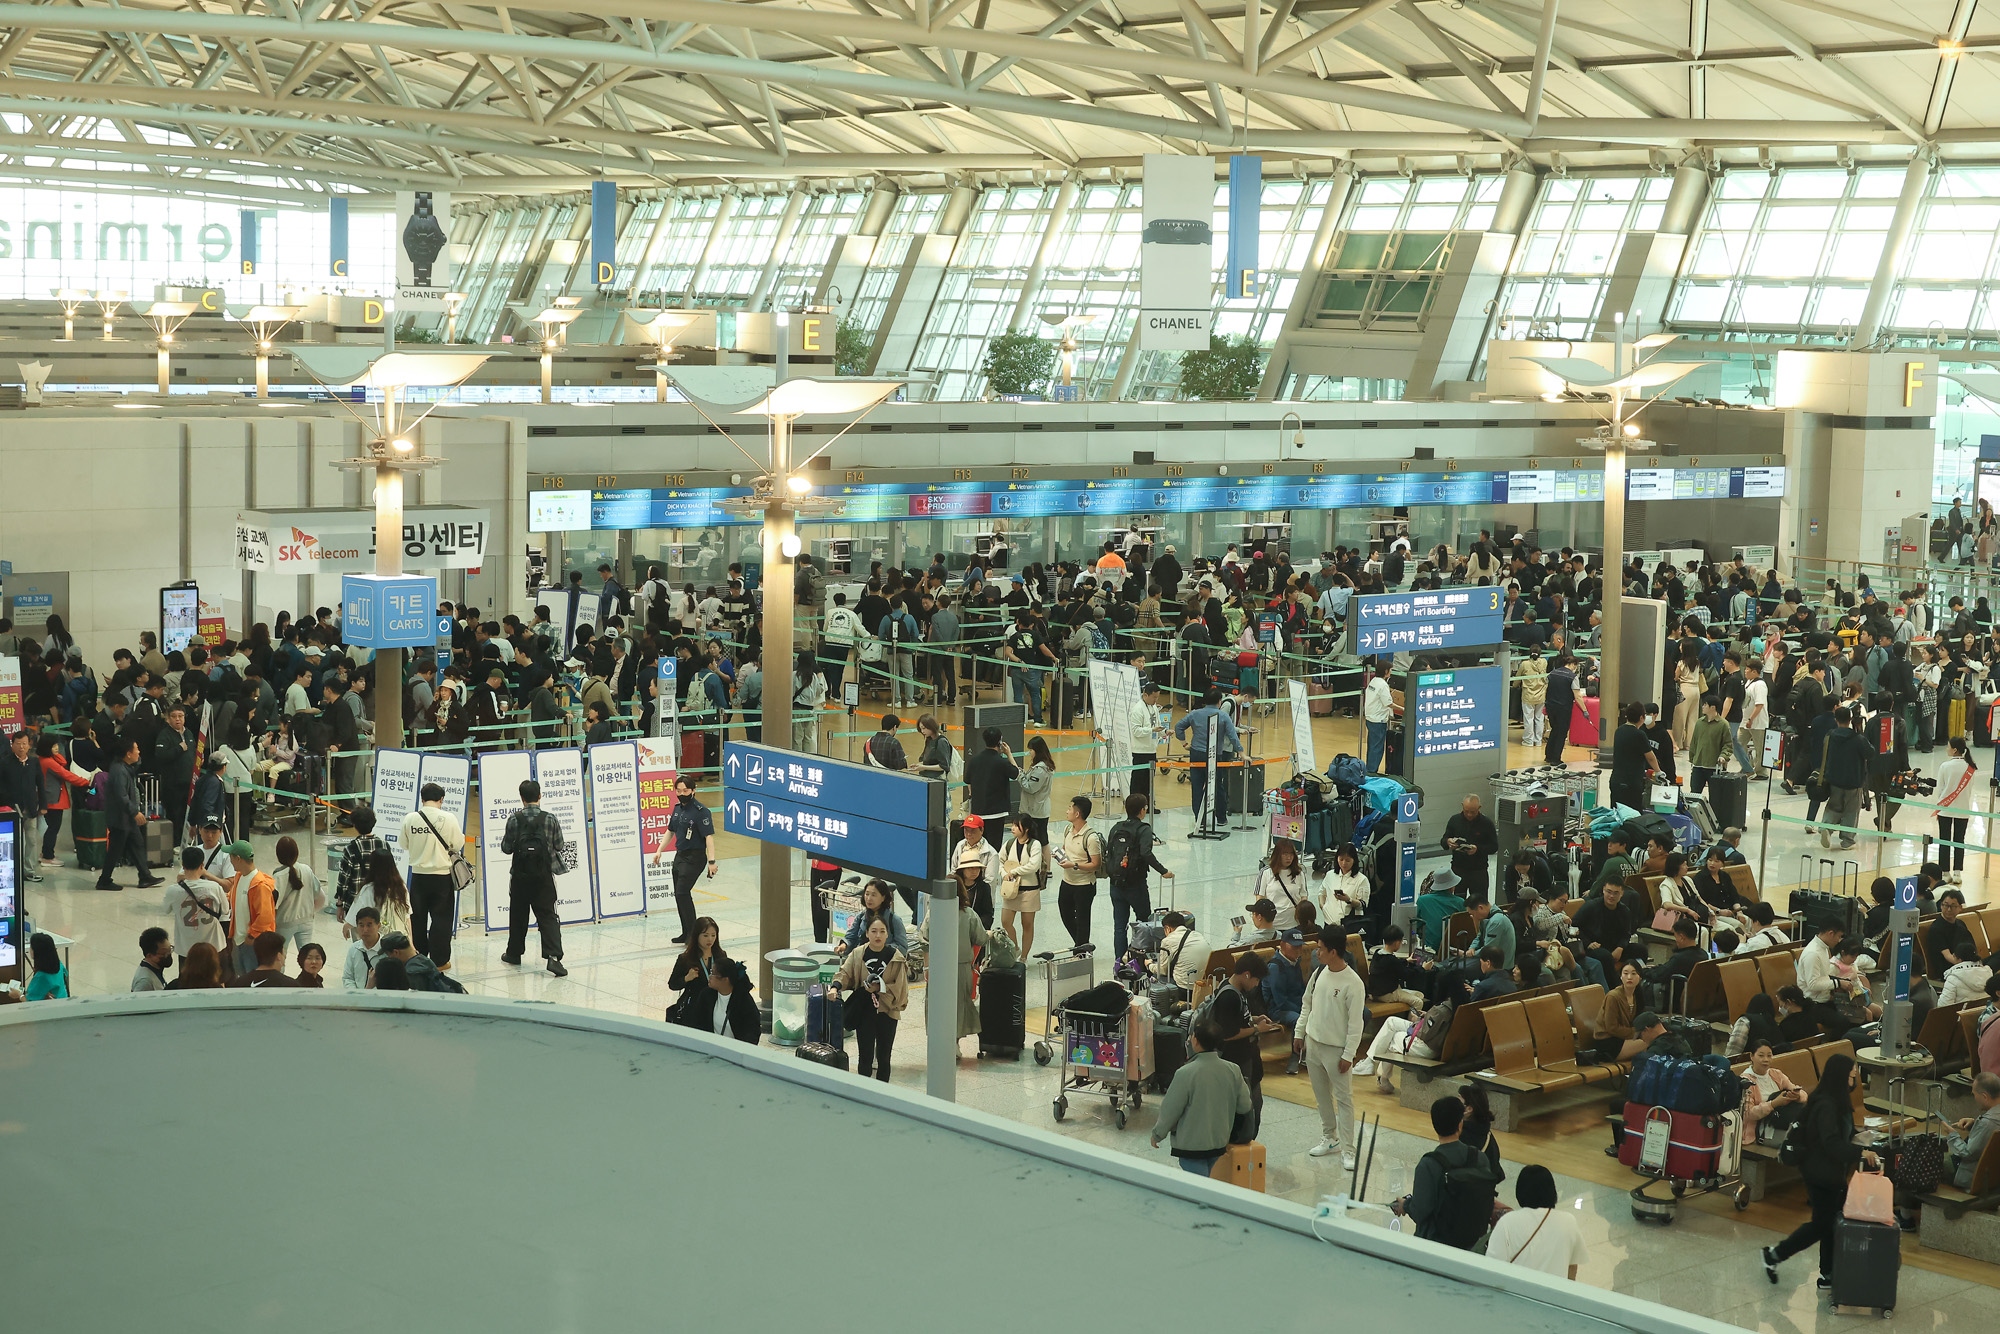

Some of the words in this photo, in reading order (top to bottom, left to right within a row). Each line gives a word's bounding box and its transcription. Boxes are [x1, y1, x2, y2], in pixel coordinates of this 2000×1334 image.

[242, 261, 254, 275] B
[333, 260, 346, 276] C
[598, 262, 614, 284] D
[1242, 269, 1255, 297] E
[402, 290, 438, 299] CHANE
[202, 291, 217, 311] C
[364, 301, 385, 325] D
[1150, 318, 1202, 330] CHANEL
[803, 319, 820, 351] E
[1904, 362, 1924, 408] F
[1400, 462, 1411, 472] F7
[1448, 460, 1458, 470] F6
[1529, 459, 1539, 470] F5
[1573, 458, 1582, 468] F4
[1650, 458, 1659, 468] F3
[1690, 456, 1700, 466] F2
[1763, 456, 1772, 466] F1
[1012, 468, 1029, 479] F12
[1113, 467, 1128, 478] F11
[1167, 466, 1183, 476] F10
[1263, 464, 1274, 474] F9
[1313, 463, 1324, 473] F8
[665, 474, 685, 486] F16
[846, 472, 864, 482] F14
[954, 469, 972, 480] F13
[543, 477, 564, 488] F18
[597, 476, 617, 488] F17
[368, 521, 484, 558] 밍센터
[278, 544, 302, 561] SK
[308, 546, 359, 560] telecom
[390, 594, 424, 616] 카트
[1490, 592, 1498, 610] 3
[1374, 602, 1410, 616] 국제선탑승
[1427, 606, 1456, 616] Boarding
[389, 618, 424, 632] CARTS
[201, 635, 221, 645] 객만
[1391, 630, 1416, 644] 주차장
[1418, 636, 1442, 646] Parking
[595, 762, 632, 772] 유심교체서비스
[638, 756, 645, 766] K
[649, 756, 672, 766] 텔레콤
[380, 768, 416, 779] 유심교체서비스
[597, 771, 632, 784] 이용안내
[768, 766, 785, 783] 도착
[380, 778, 414, 792] 이용안내
[788, 781, 819, 798] Arrivals
[640, 796, 670, 810] 여객만
[768, 812, 793, 832] 주차장
[411, 826, 431, 834] bea
[798, 830, 828, 850] Parking
